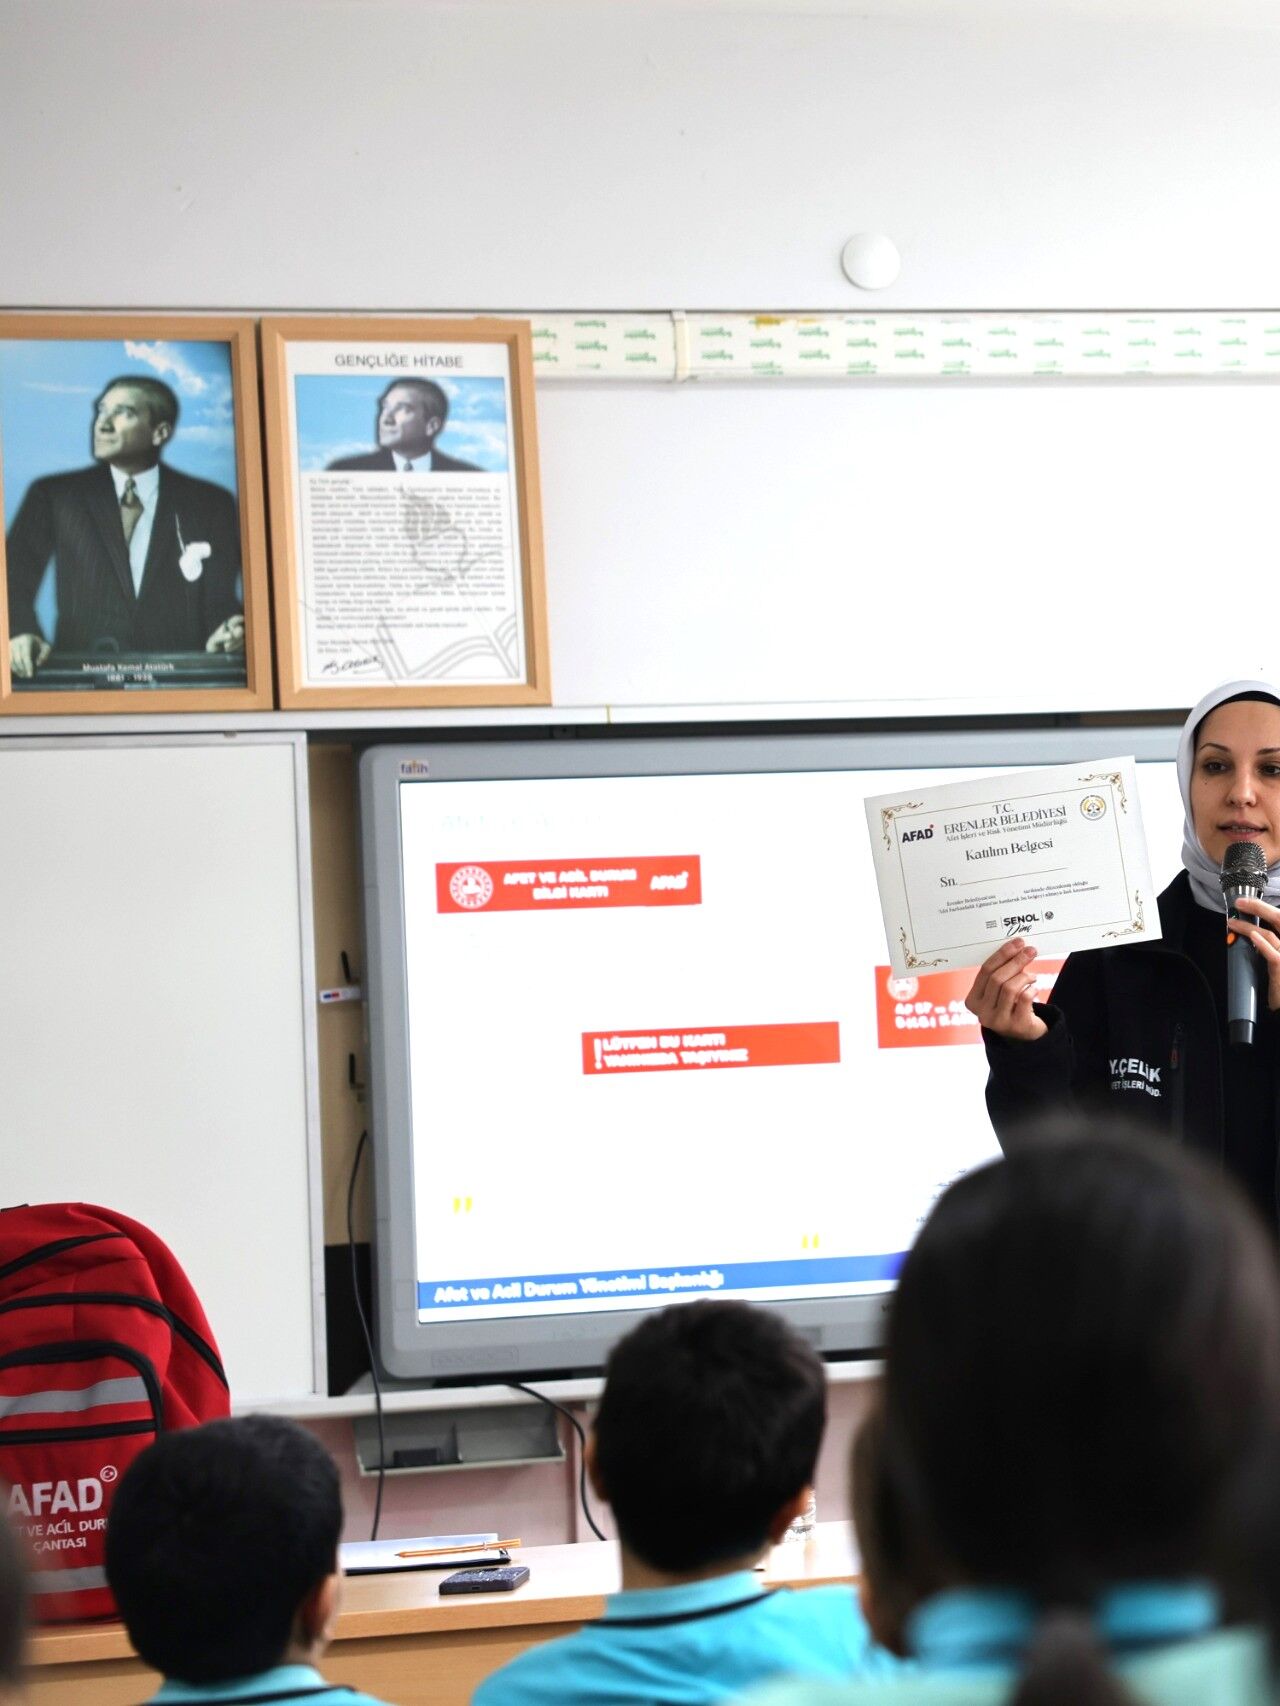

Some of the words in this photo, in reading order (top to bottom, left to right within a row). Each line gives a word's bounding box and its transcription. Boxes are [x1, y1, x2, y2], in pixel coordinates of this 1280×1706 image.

[334, 351, 409, 370] GENÇLİĞE
[413, 352, 464, 368] HİTABE
[944, 816, 998, 834] ERENLER
[1000, 804, 1067, 826] BELEDİYESİ
[902, 827, 934, 843] AFAD
[965, 845, 1009, 861] Katılım
[1011, 838, 1054, 854] Belgesi
[940, 876, 958, 888] Sn.
[434, 1287, 469, 1303] Afet
[470, 1287, 490, 1300] ve
[492, 1282, 521, 1299] Acil
[524, 1280, 578, 1298] Durum
[6, 1477, 103, 1517] AFAD
[27, 1525, 43, 1537] VE
[46, 1519, 75, 1536] ACİL
[79, 1517, 108, 1532] DUR
[33, 1537, 87, 1555] ÇANTASI
